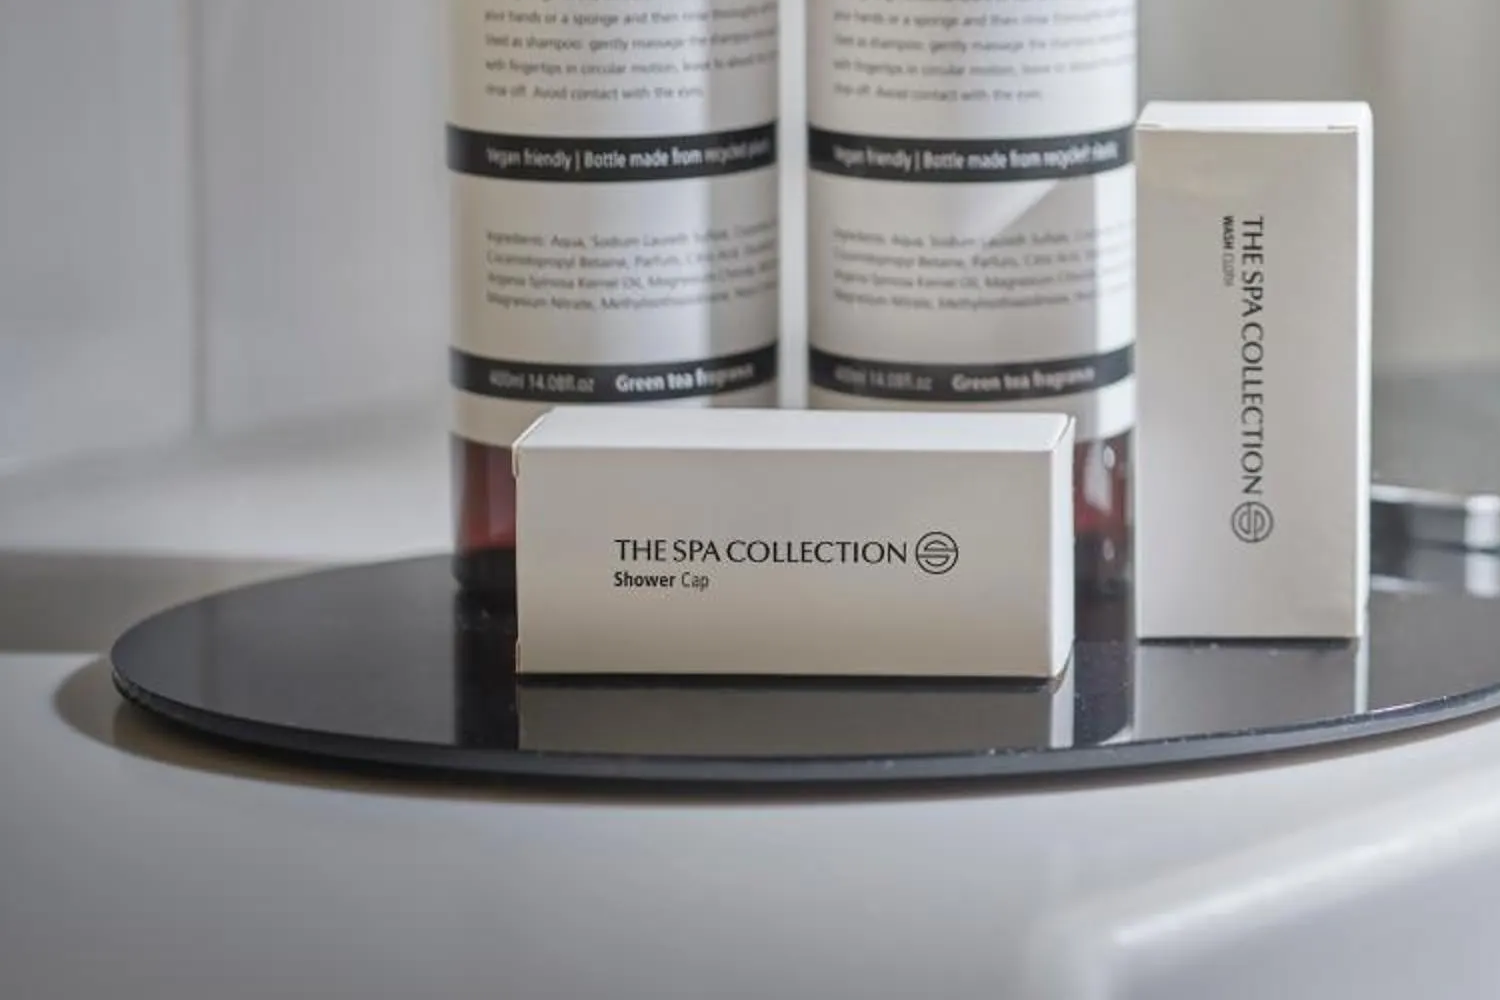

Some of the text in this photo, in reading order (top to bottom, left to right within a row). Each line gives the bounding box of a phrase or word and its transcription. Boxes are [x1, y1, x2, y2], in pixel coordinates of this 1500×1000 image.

[523, 148, 572, 173] friendly
[583, 149, 627, 169] Bottle
[629, 149, 669, 168] made
[671, 146, 703, 167] from
[922, 149, 966, 169] Bottle
[967, 149, 1007, 169] made
[1222, 215, 1235, 250] WASH
[1241, 216, 1264, 495] THE SPA COLLECTION
[615, 371, 665, 392] Green
[667, 372, 694, 391] tea
[951, 373, 1001, 392] Green
[1003, 373, 1030, 391] tea
[614, 538, 907, 564] THE SPA COLLECTION
[614, 571, 709, 592] Shower Cap
